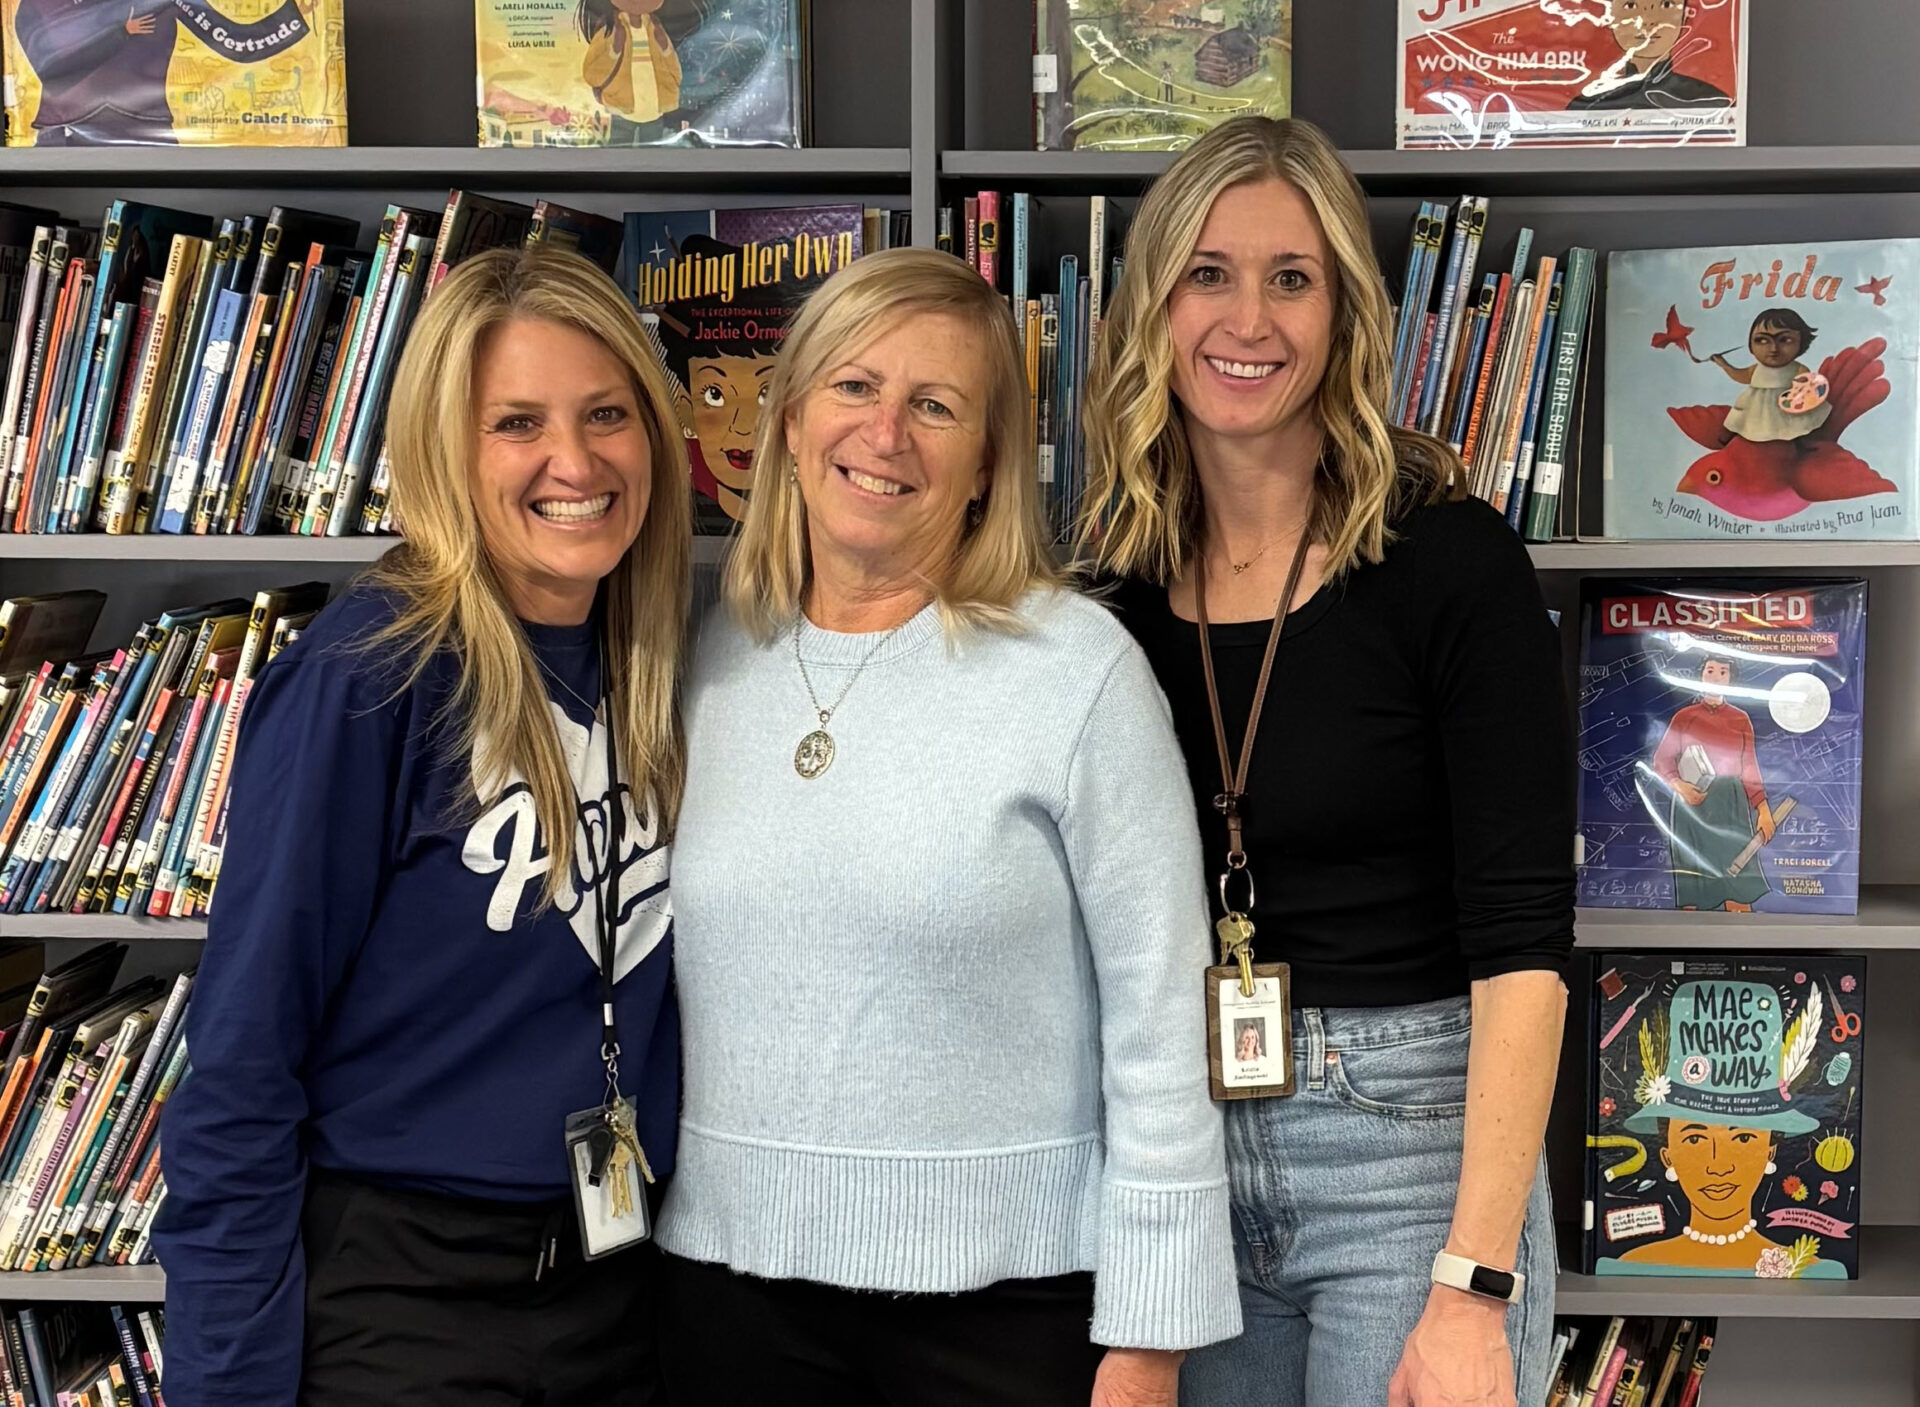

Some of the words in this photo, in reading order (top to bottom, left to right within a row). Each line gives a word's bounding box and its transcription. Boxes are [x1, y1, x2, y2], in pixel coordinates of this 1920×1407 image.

[194, 12, 211, 31] is
[212, 18, 301, 53] Gertrude
[1492, 31, 1516, 44] The
[1416, 54, 1492, 73] WONG
[638, 250, 736, 308] Holding
[741, 239, 788, 290] Her
[794, 231, 853, 281] Own
[1699, 254, 1844, 309] Frida
[35, 318, 47, 352] WHEN
[695, 322, 740, 341] Jackie
[1558, 331, 1577, 373] FIRST
[26, 354, 40, 397] MARIAN
[1551, 374, 1570, 411] GIRL
[1544, 415, 1564, 461] SCOUT
[1652, 498, 1664, 515] by
[1666, 498, 1702, 524] Jonah
[1707, 512, 1752, 535] Winter
[1774, 520, 1820, 534] illustrated
[1823, 519, 1838, 534] by
[1837, 510, 1864, 527] Ana
[1870, 504, 1901, 529] Juan
[1609, 595, 1807, 629] CLASSIFIED
[1780, 633, 1809, 643] GOLDA
[1780, 643, 1818, 653] Engineer
[28, 729, 47, 763] GEORGE
[22, 761, 33, 773] W.
[138, 749, 163, 798] DIFFERENT
[13, 774, 28, 796] BUSH
[127, 796, 144, 818] LIKE
[1774, 858, 1798, 867] TRACI
[1693, 984, 1753, 1020] MAE
[1679, 1019, 1768, 1056] MAKES
[1689, 1062, 1701, 1075] a
[1711, 1055, 1770, 1089] WAY
[90, 1135, 118, 1186] JOURNEY
